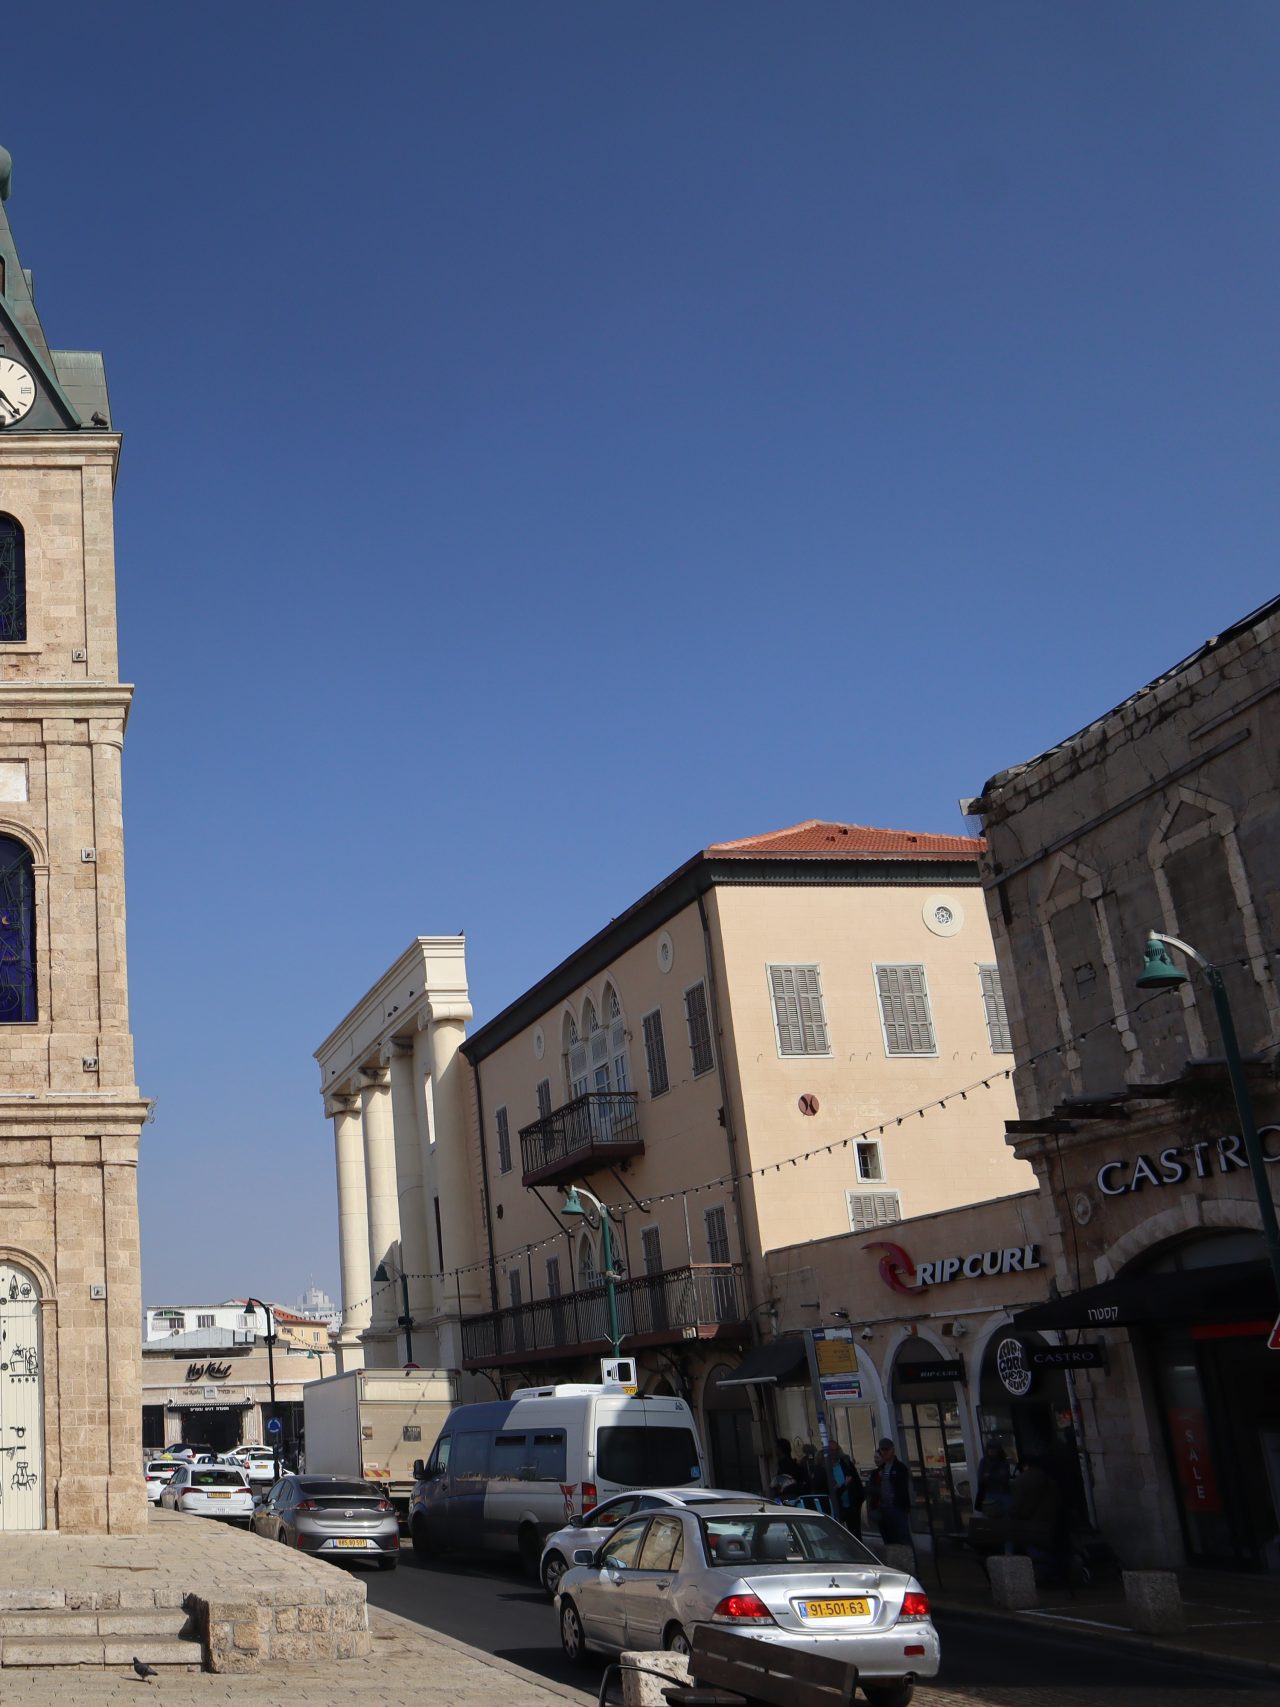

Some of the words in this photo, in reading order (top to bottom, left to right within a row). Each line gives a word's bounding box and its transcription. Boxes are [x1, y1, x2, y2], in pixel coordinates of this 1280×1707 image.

[916, 1257, 960, 1286] RIP
[962, 1244, 1040, 1279] CURL
[1088, 1306, 1119, 1320] קסטרו
[1033, 1351, 1095, 1363] CASTRO
[1184, 1428, 1206, 1499] SALE
